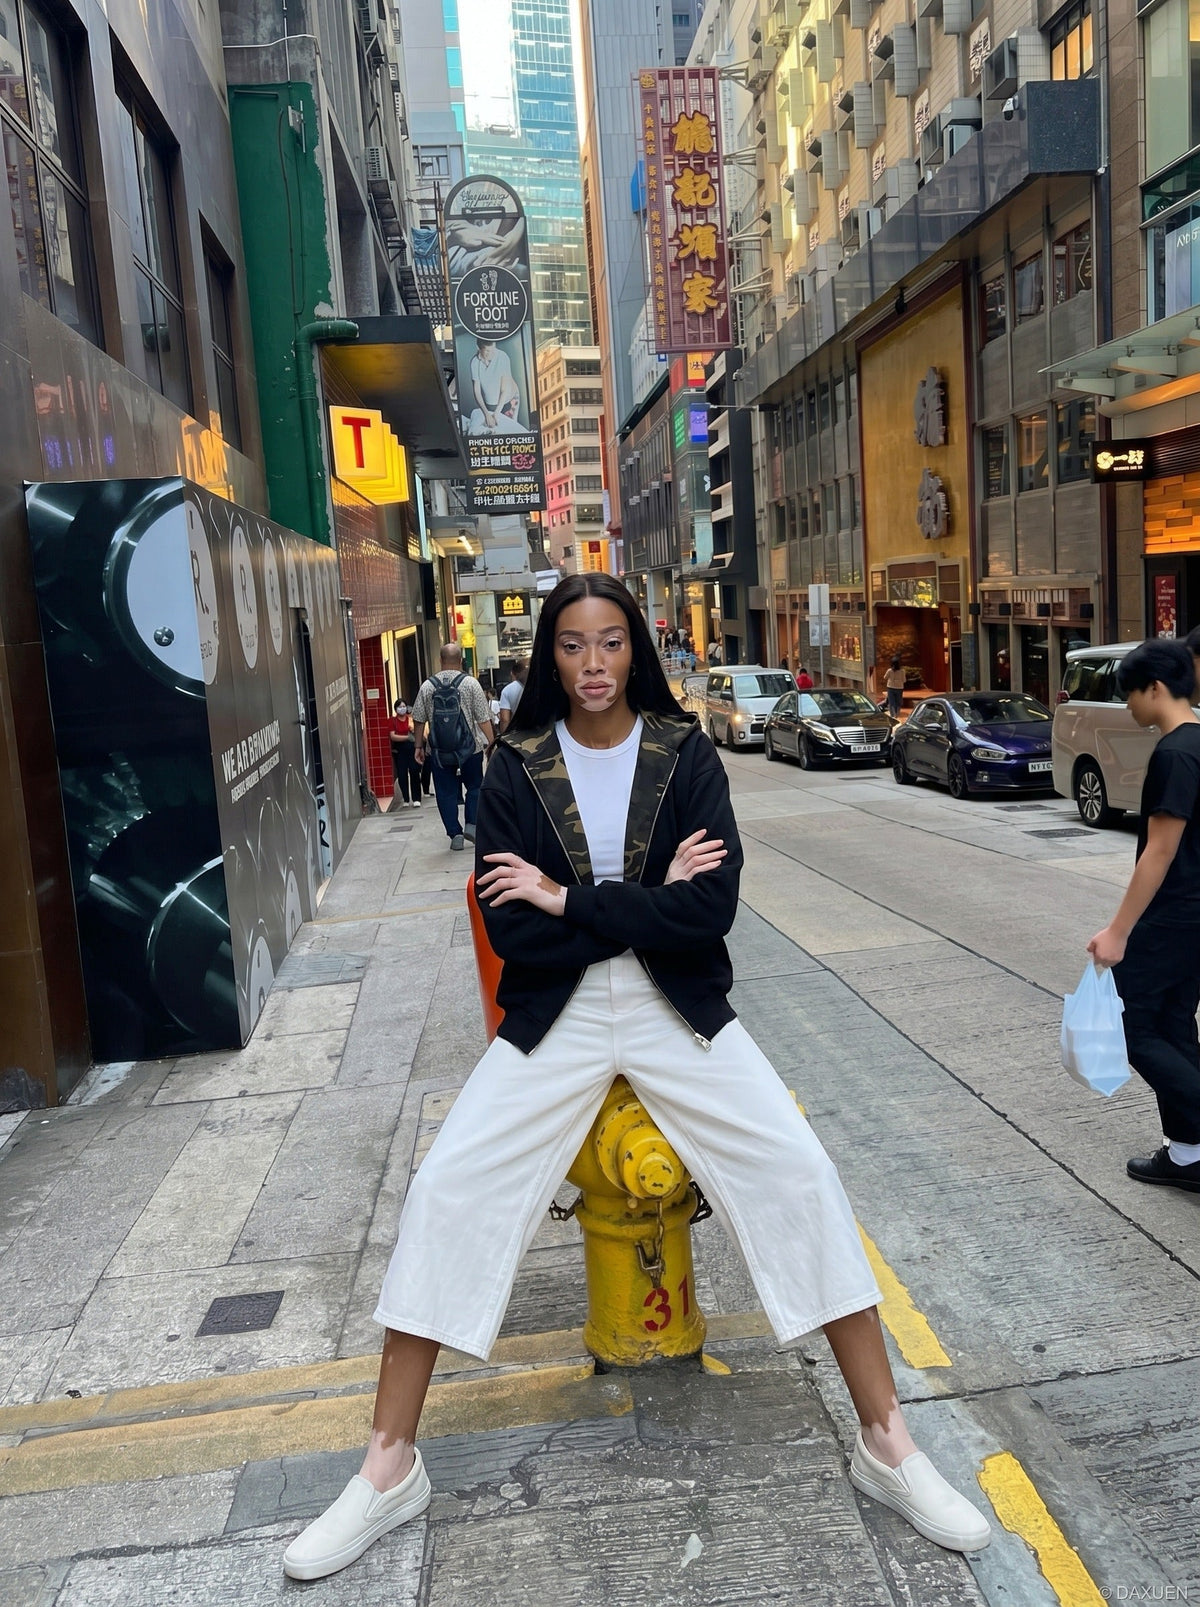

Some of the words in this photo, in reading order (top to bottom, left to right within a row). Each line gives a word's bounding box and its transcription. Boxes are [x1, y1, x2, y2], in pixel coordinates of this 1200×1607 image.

[463, 291, 520, 307] FORTUNE
[474, 306, 509, 322] FOOT
[341, 416, 371, 468] T
[643, 1273, 690, 1333] 31
